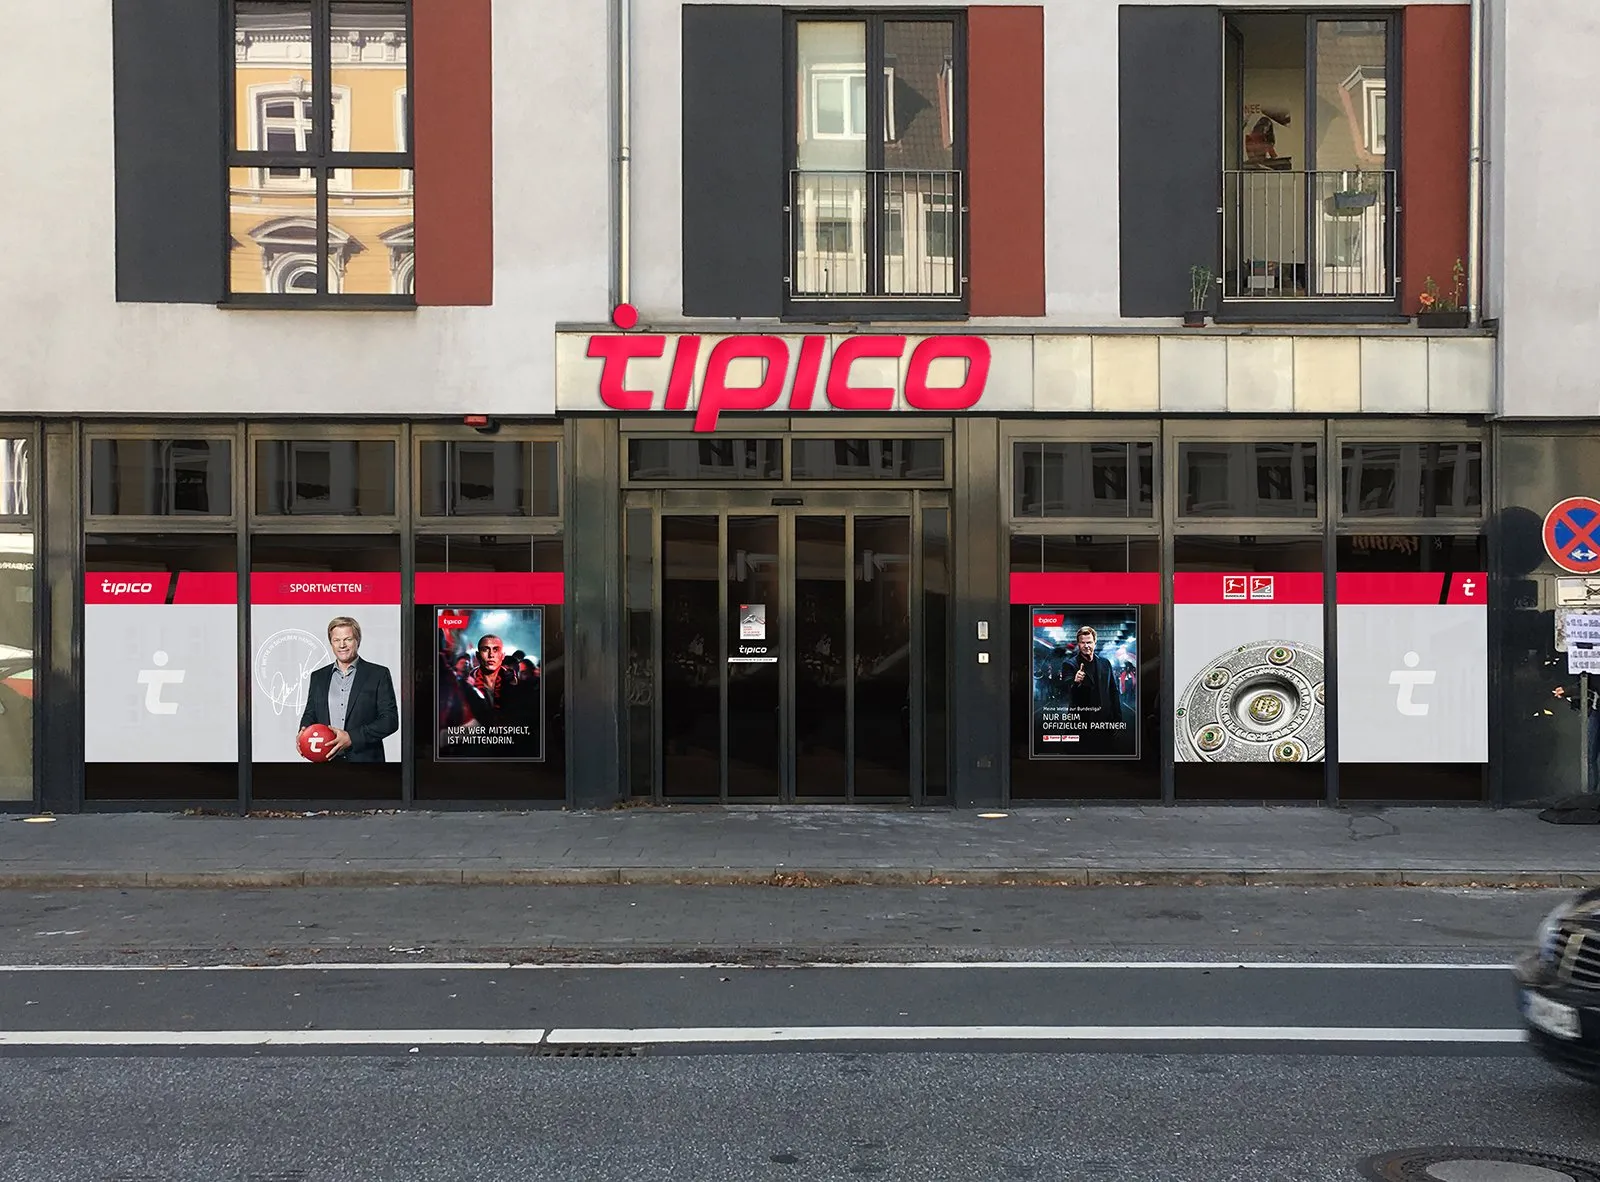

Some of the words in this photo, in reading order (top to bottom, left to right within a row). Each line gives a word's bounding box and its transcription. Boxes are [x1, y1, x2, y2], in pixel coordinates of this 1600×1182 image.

[587, 303, 992, 432] tipico
[101, 579, 153, 595] tipico
[289, 583, 362, 593] SPORTWETTEN
[739, 645, 767, 655] tipico
[1043, 713, 1060, 721] NUR
[1061, 713, 1081, 721] BEIM
[447, 726, 466, 735] NUR
[468, 726, 486, 735] WER
[488, 726, 530, 736] MITSPIELT,
[1042, 722, 1088, 730] OFFIZIELLEN
[1090, 722, 1127, 730] PARTNER!
[447, 736, 459, 745] IST
[461, 736, 515, 745] MITTENDRIN.
